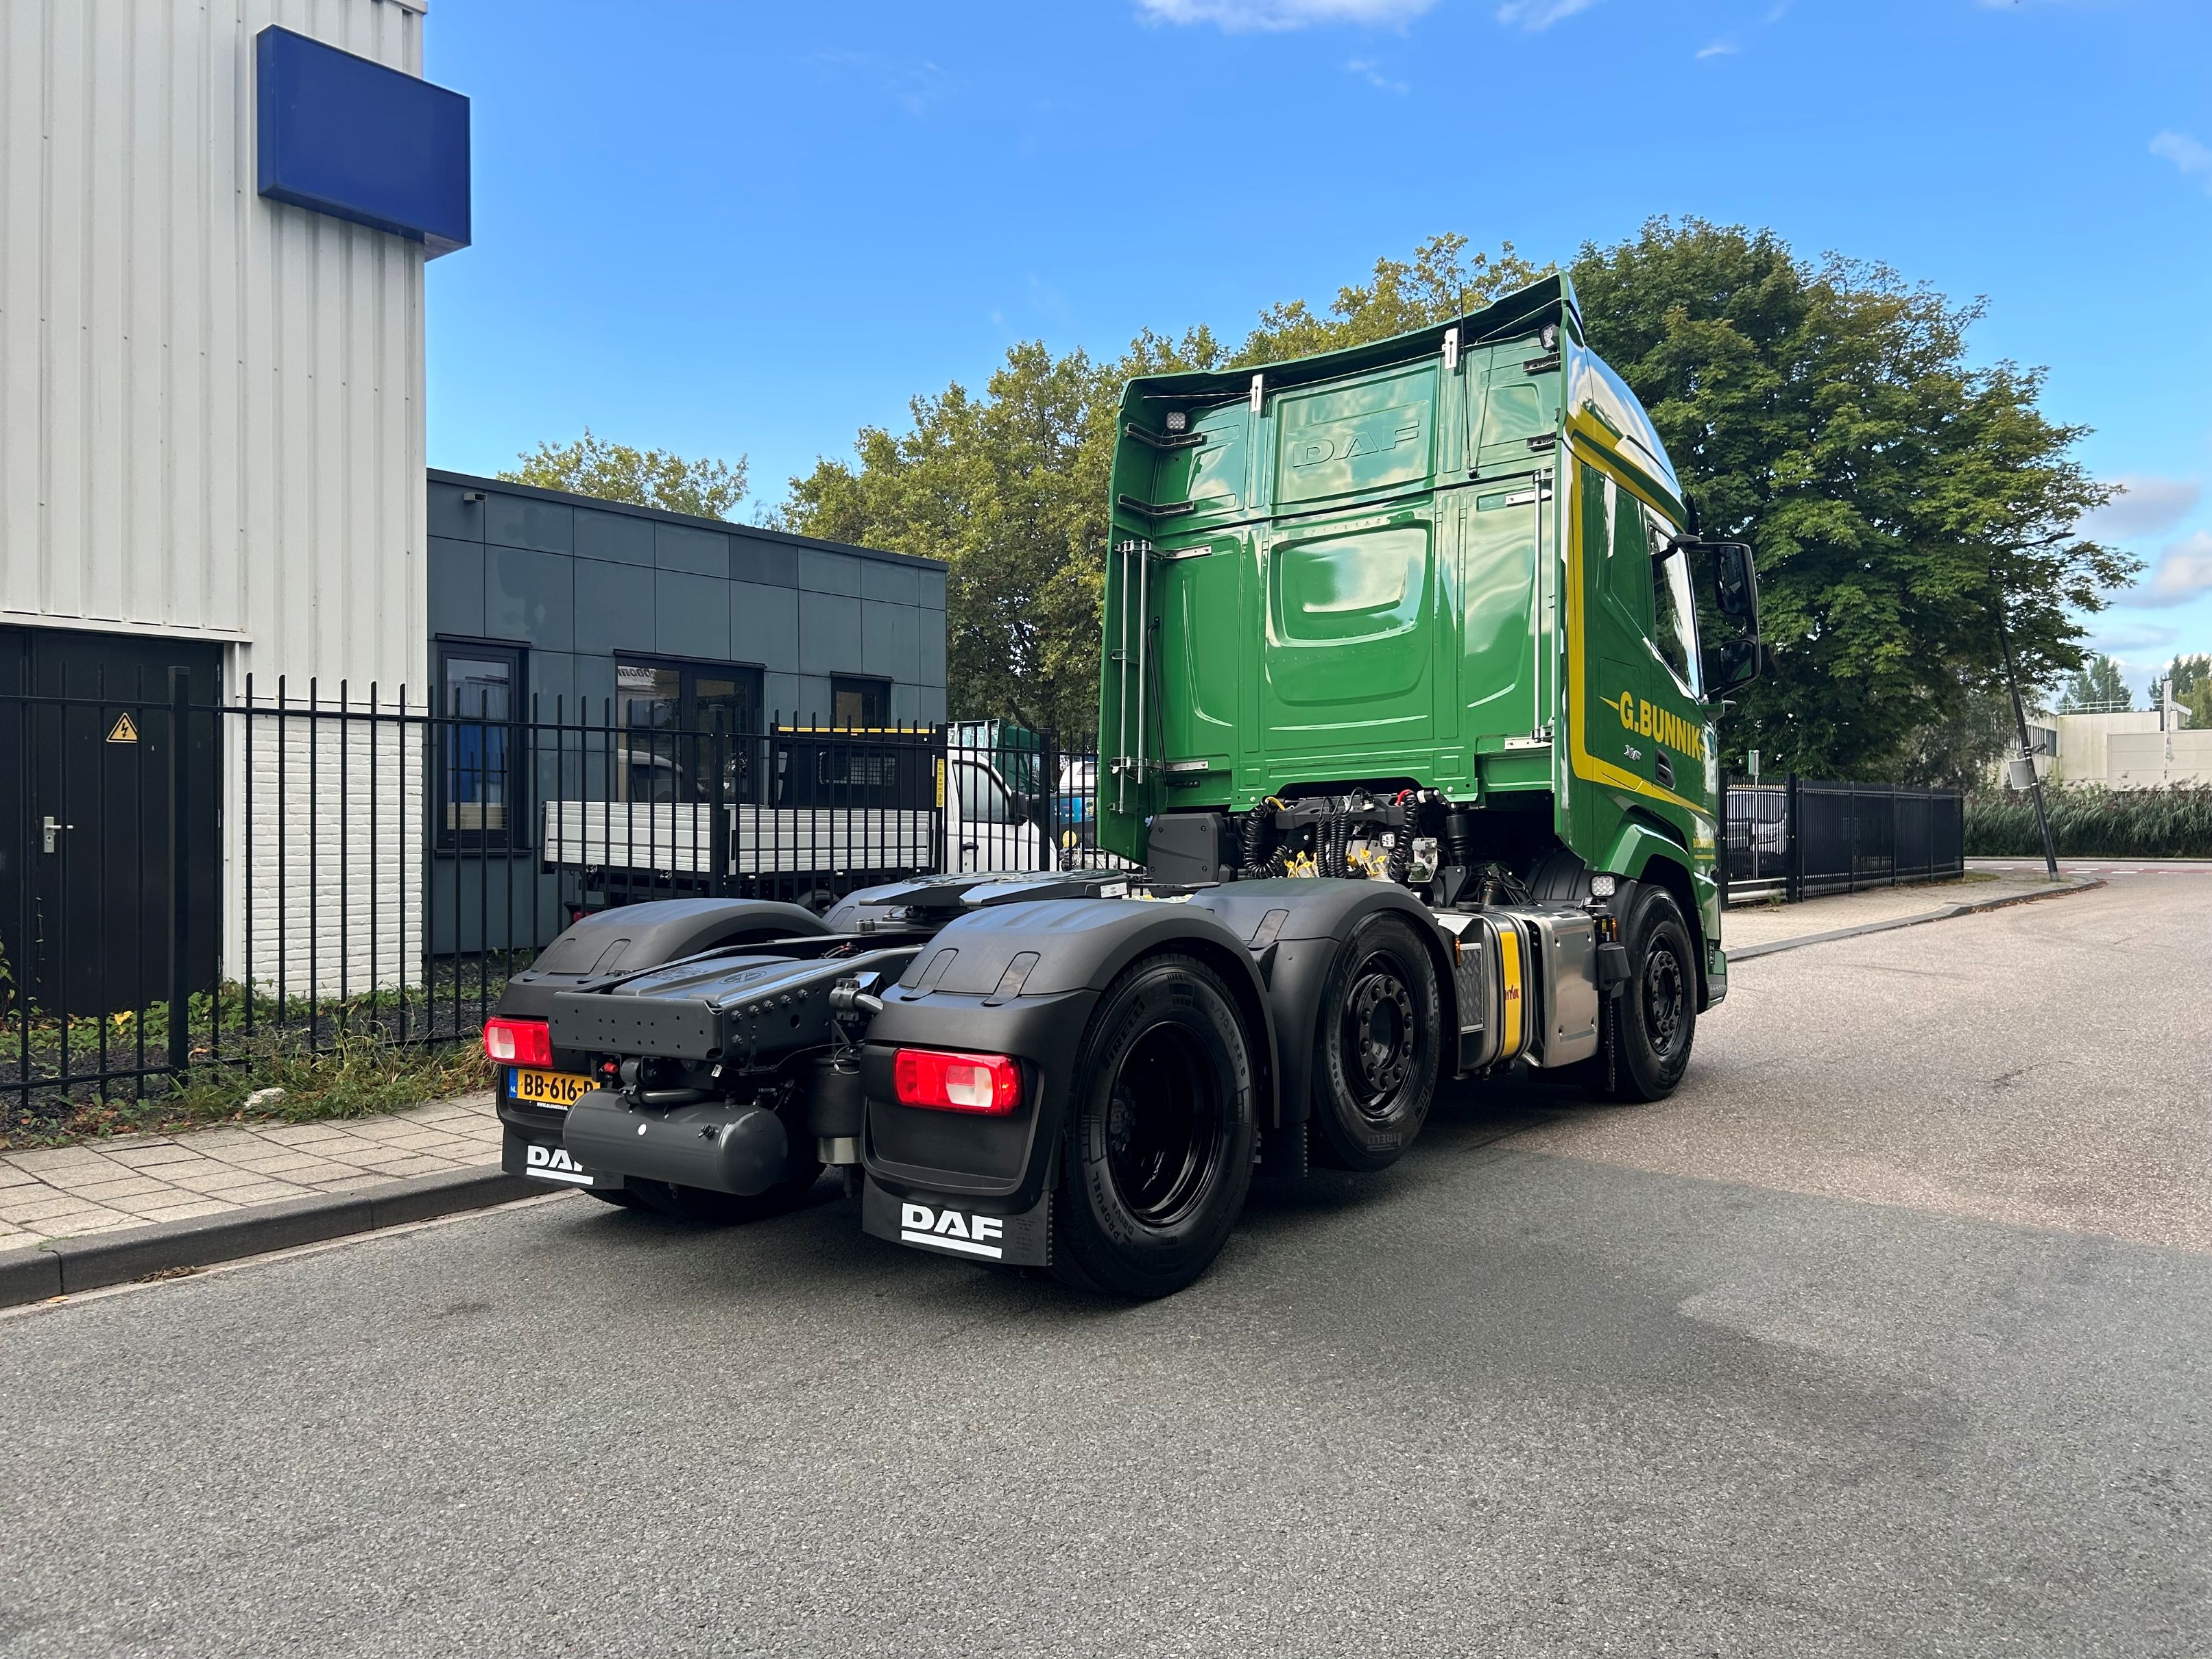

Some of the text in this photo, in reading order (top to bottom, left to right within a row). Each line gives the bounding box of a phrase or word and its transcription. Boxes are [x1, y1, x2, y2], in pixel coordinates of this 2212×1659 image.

[1293, 419, 1419, 468] DAF
[1620, 690, 1702, 762] G.BUNNIK
[1623, 744, 1642, 761] XF
[1099, 994, 1146, 1071] PIRELLI
[901, 1202, 1003, 1241] DAF
